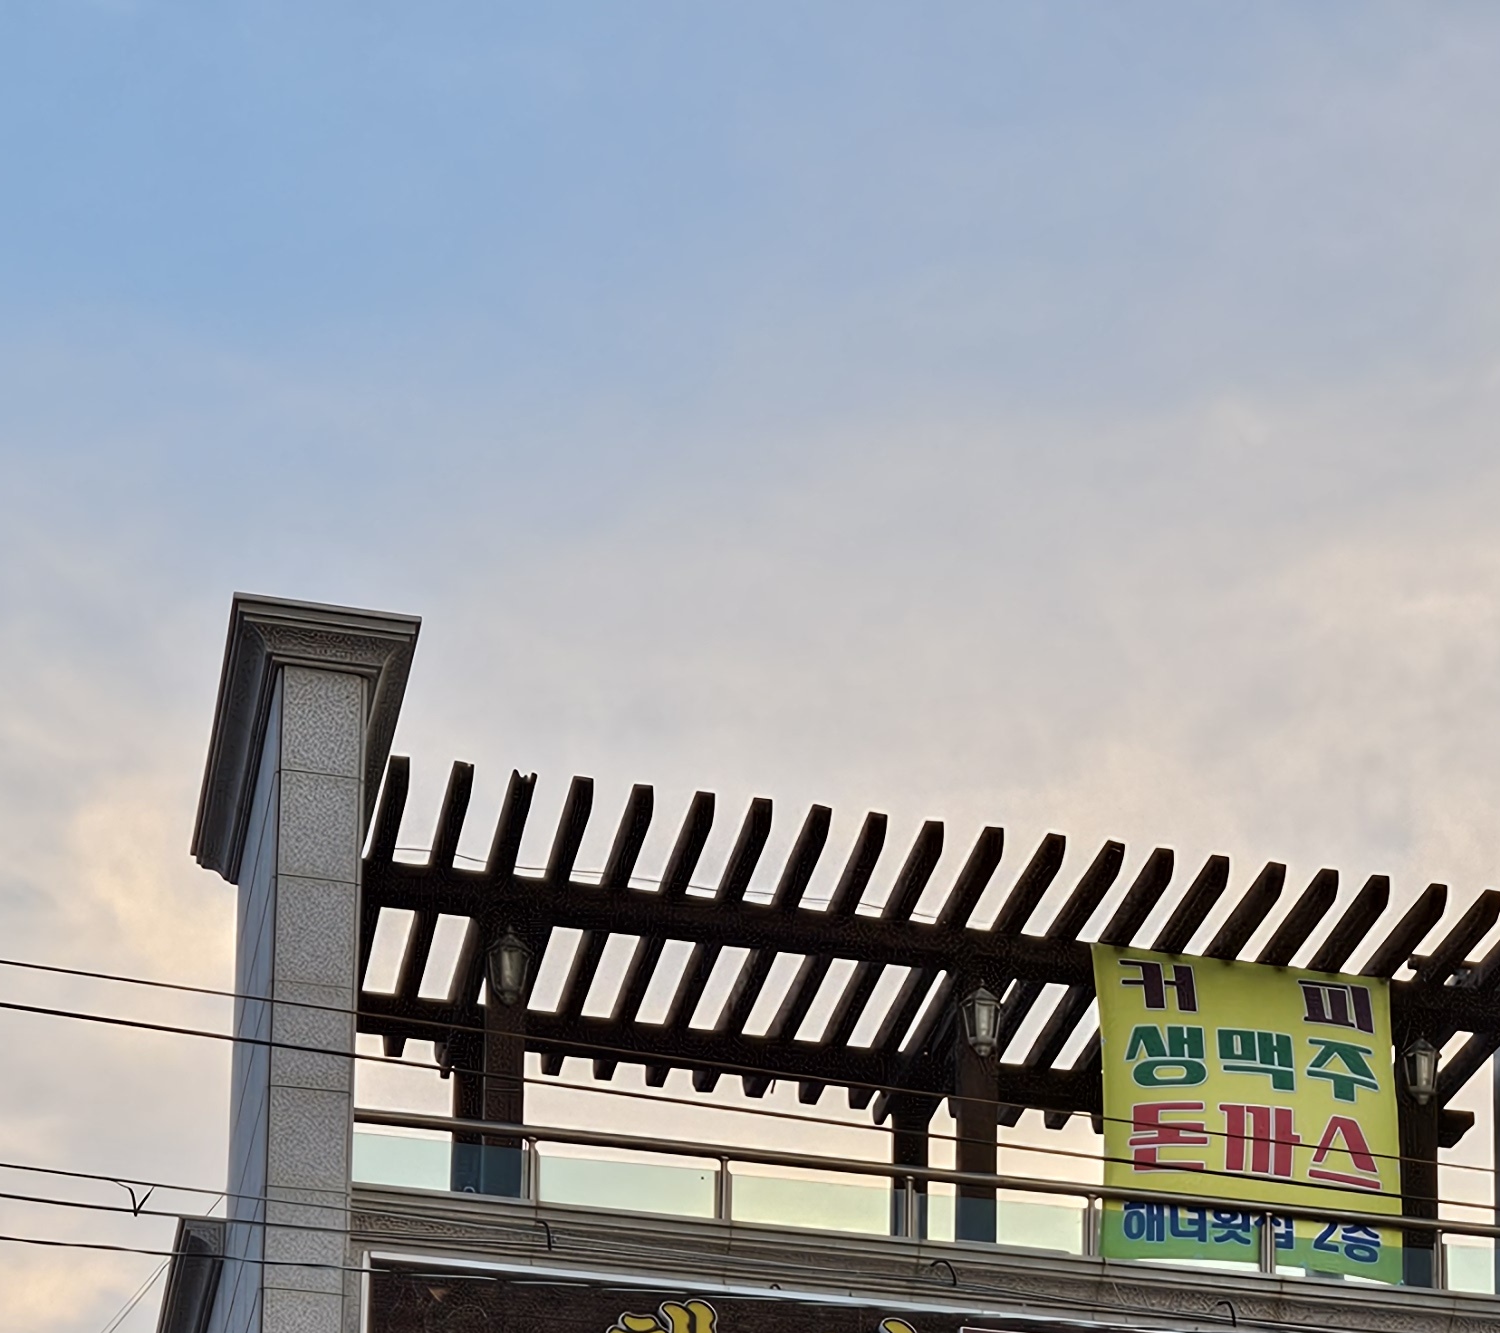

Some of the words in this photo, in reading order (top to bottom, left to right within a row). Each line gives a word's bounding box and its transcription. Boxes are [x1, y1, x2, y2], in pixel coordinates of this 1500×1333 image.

[1119, 959, 1375, 1034] 커피
[1125, 1025, 1380, 1103] 생맥주
[1128, 1101, 1382, 1190] 돈까스
